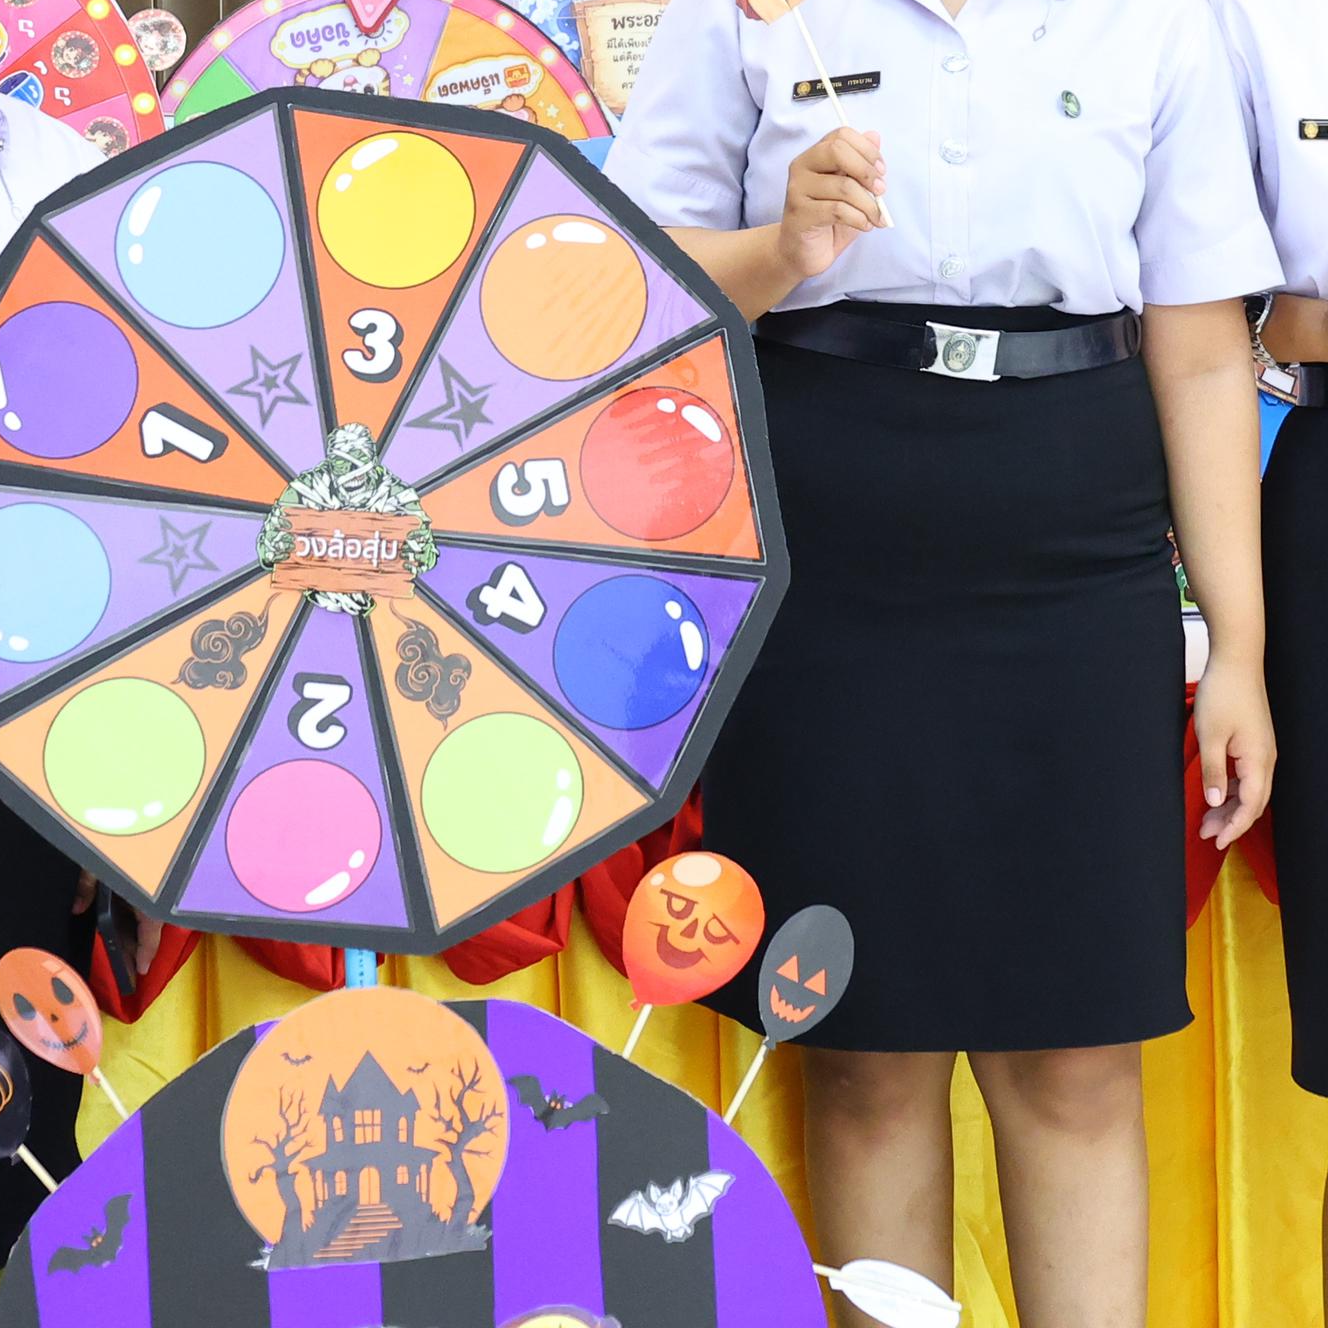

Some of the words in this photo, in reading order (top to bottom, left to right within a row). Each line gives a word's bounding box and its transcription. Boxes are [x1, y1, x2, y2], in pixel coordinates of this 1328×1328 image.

[289, 21, 351, 53] ข้อคิด
[437, 72, 501, 98] แจ็คพอต
[343, 308, 404, 382] 3
[139, 405, 230, 462] 1
[492, 458, 571, 526] 5
[295, 529, 399, 568] วงล้อสุ่ม
[475, 562, 549, 632] 4
[291, 675, 354, 749] 2
